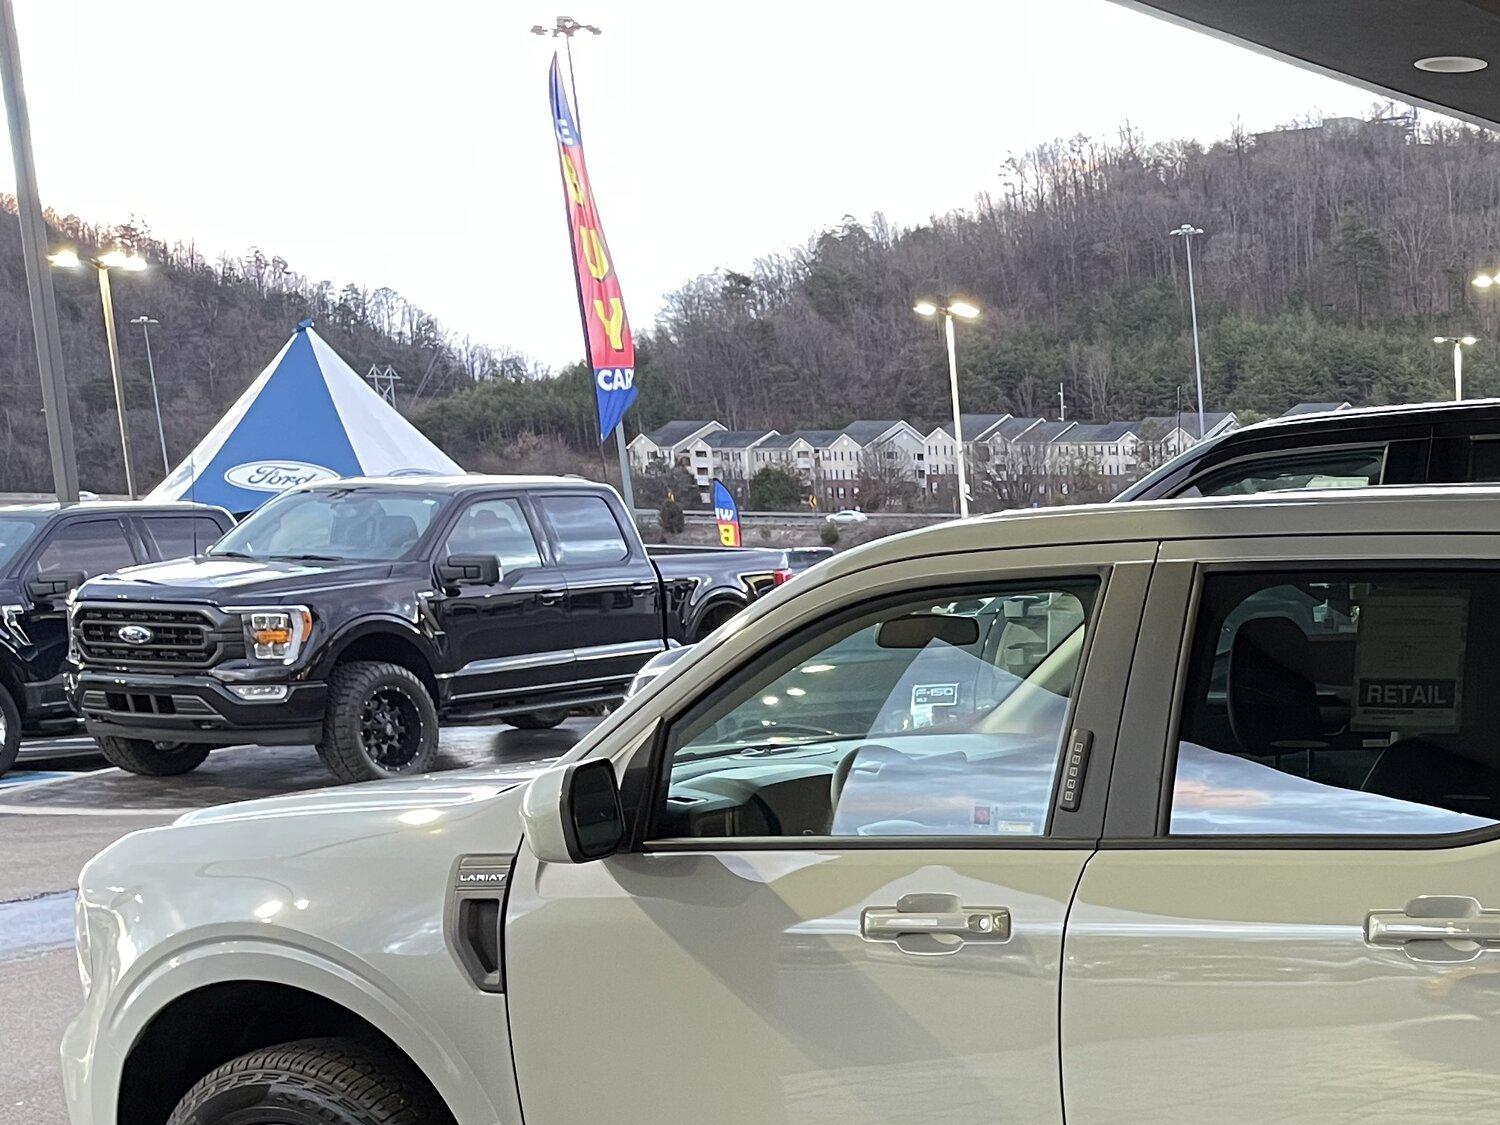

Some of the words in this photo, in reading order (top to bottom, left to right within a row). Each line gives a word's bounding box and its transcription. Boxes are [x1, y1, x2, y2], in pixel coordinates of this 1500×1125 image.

[560, 153, 625, 352] BUY
[247, 465, 317, 486] Ford
[1366, 684, 1447, 705] RETAIL
[460, 873, 506, 882] LARIAT
